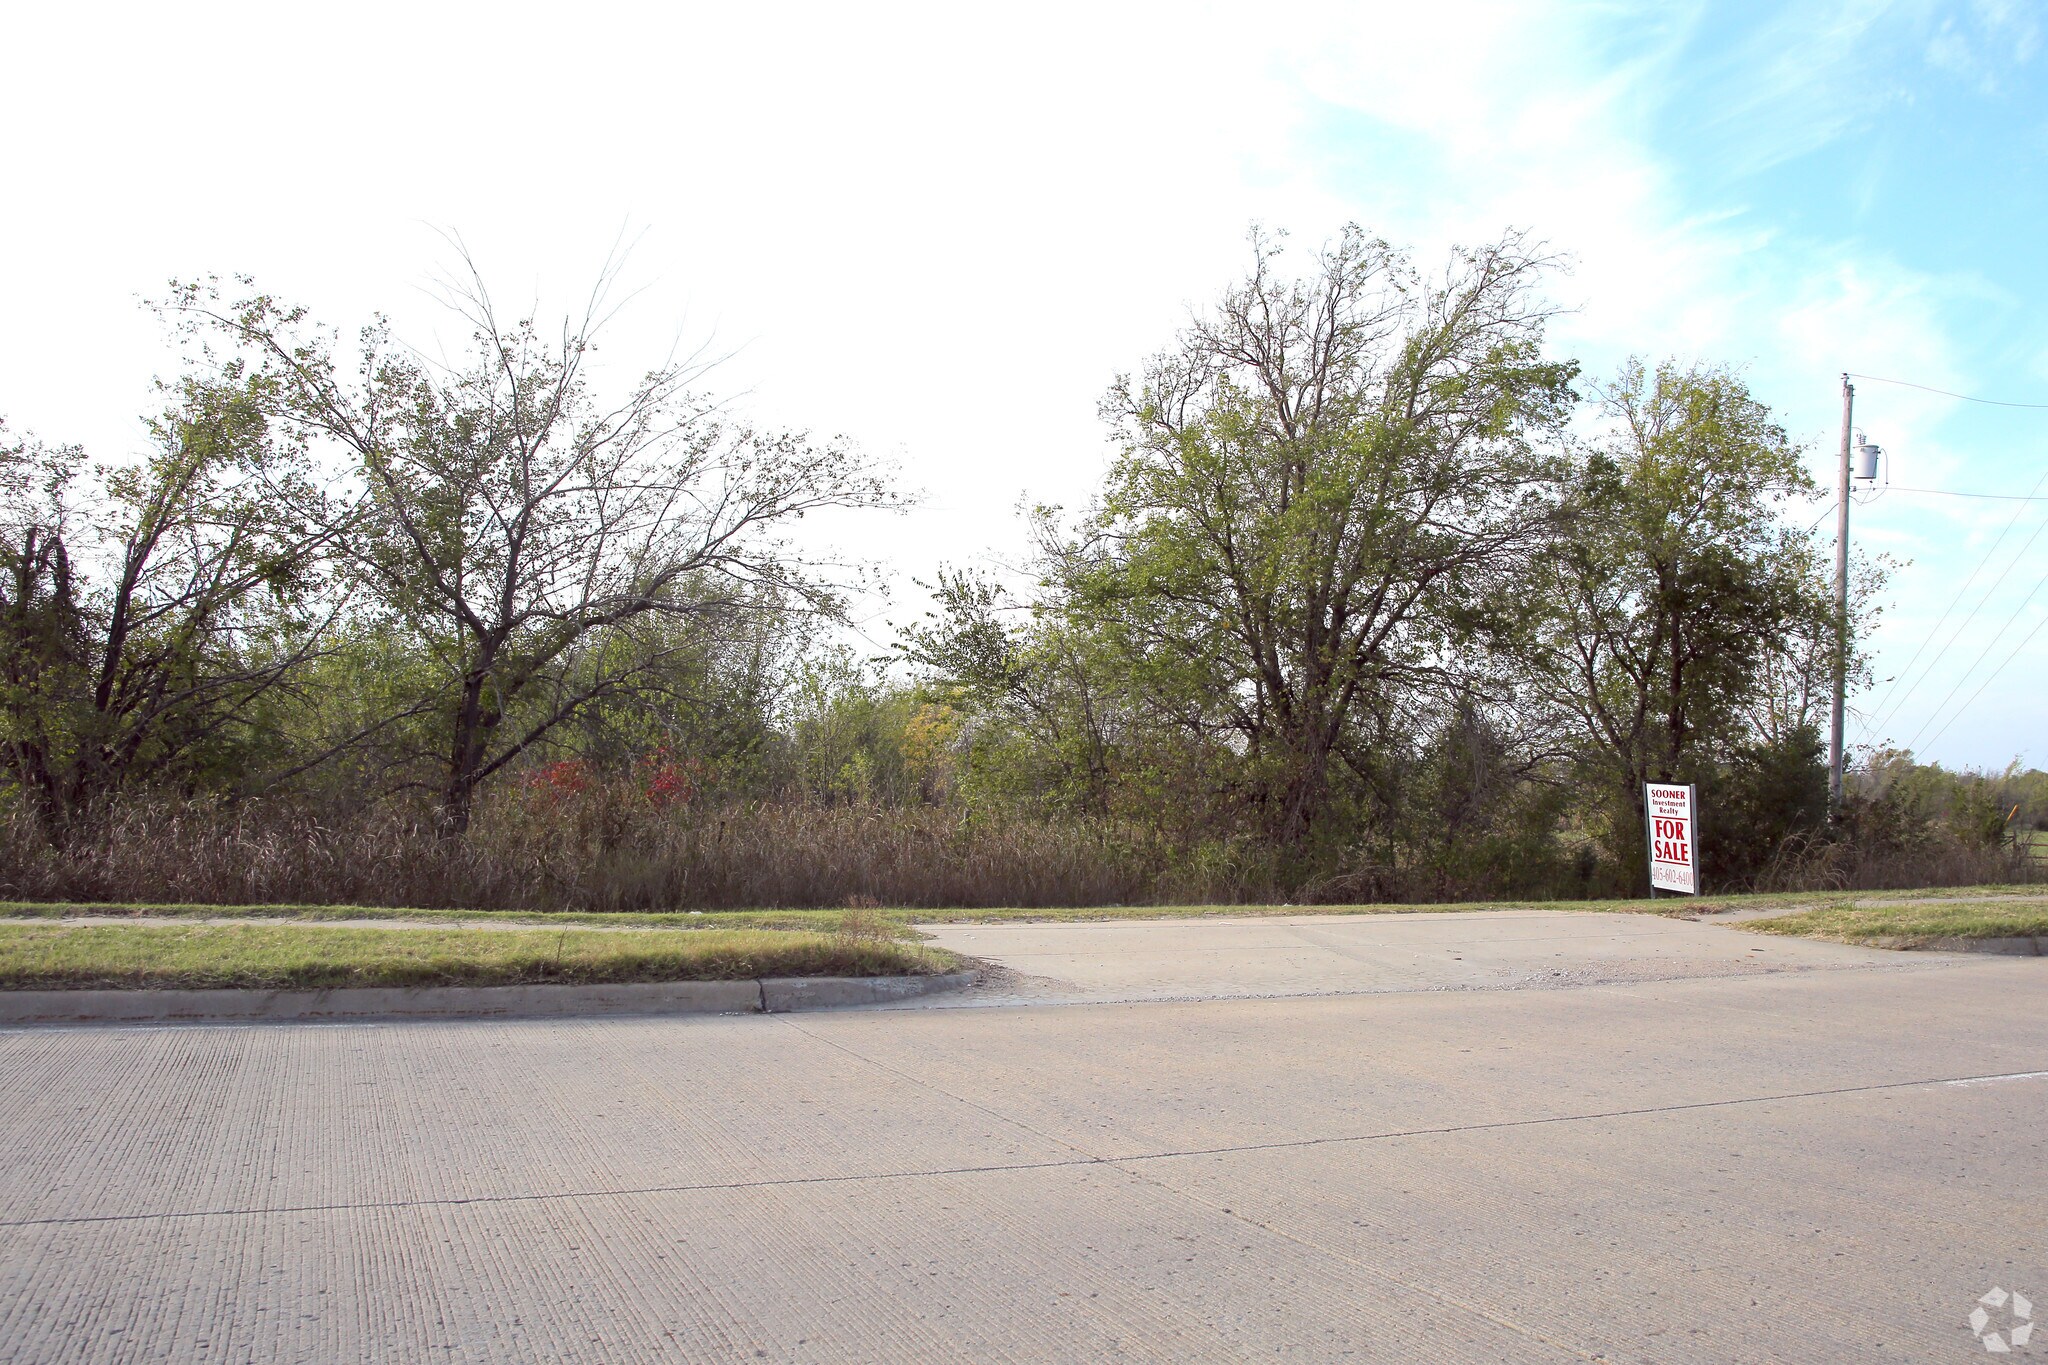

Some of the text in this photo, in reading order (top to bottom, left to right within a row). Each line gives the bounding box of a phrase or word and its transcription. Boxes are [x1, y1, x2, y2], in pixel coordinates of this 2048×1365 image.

[1651, 789, 1686, 799] SOONER
[1652, 799, 1686, 807] Investment
[1659, 807, 1679, 816] Realty
[1655, 820, 1685, 840] FOR
[1655, 840, 1689, 861] SALE
